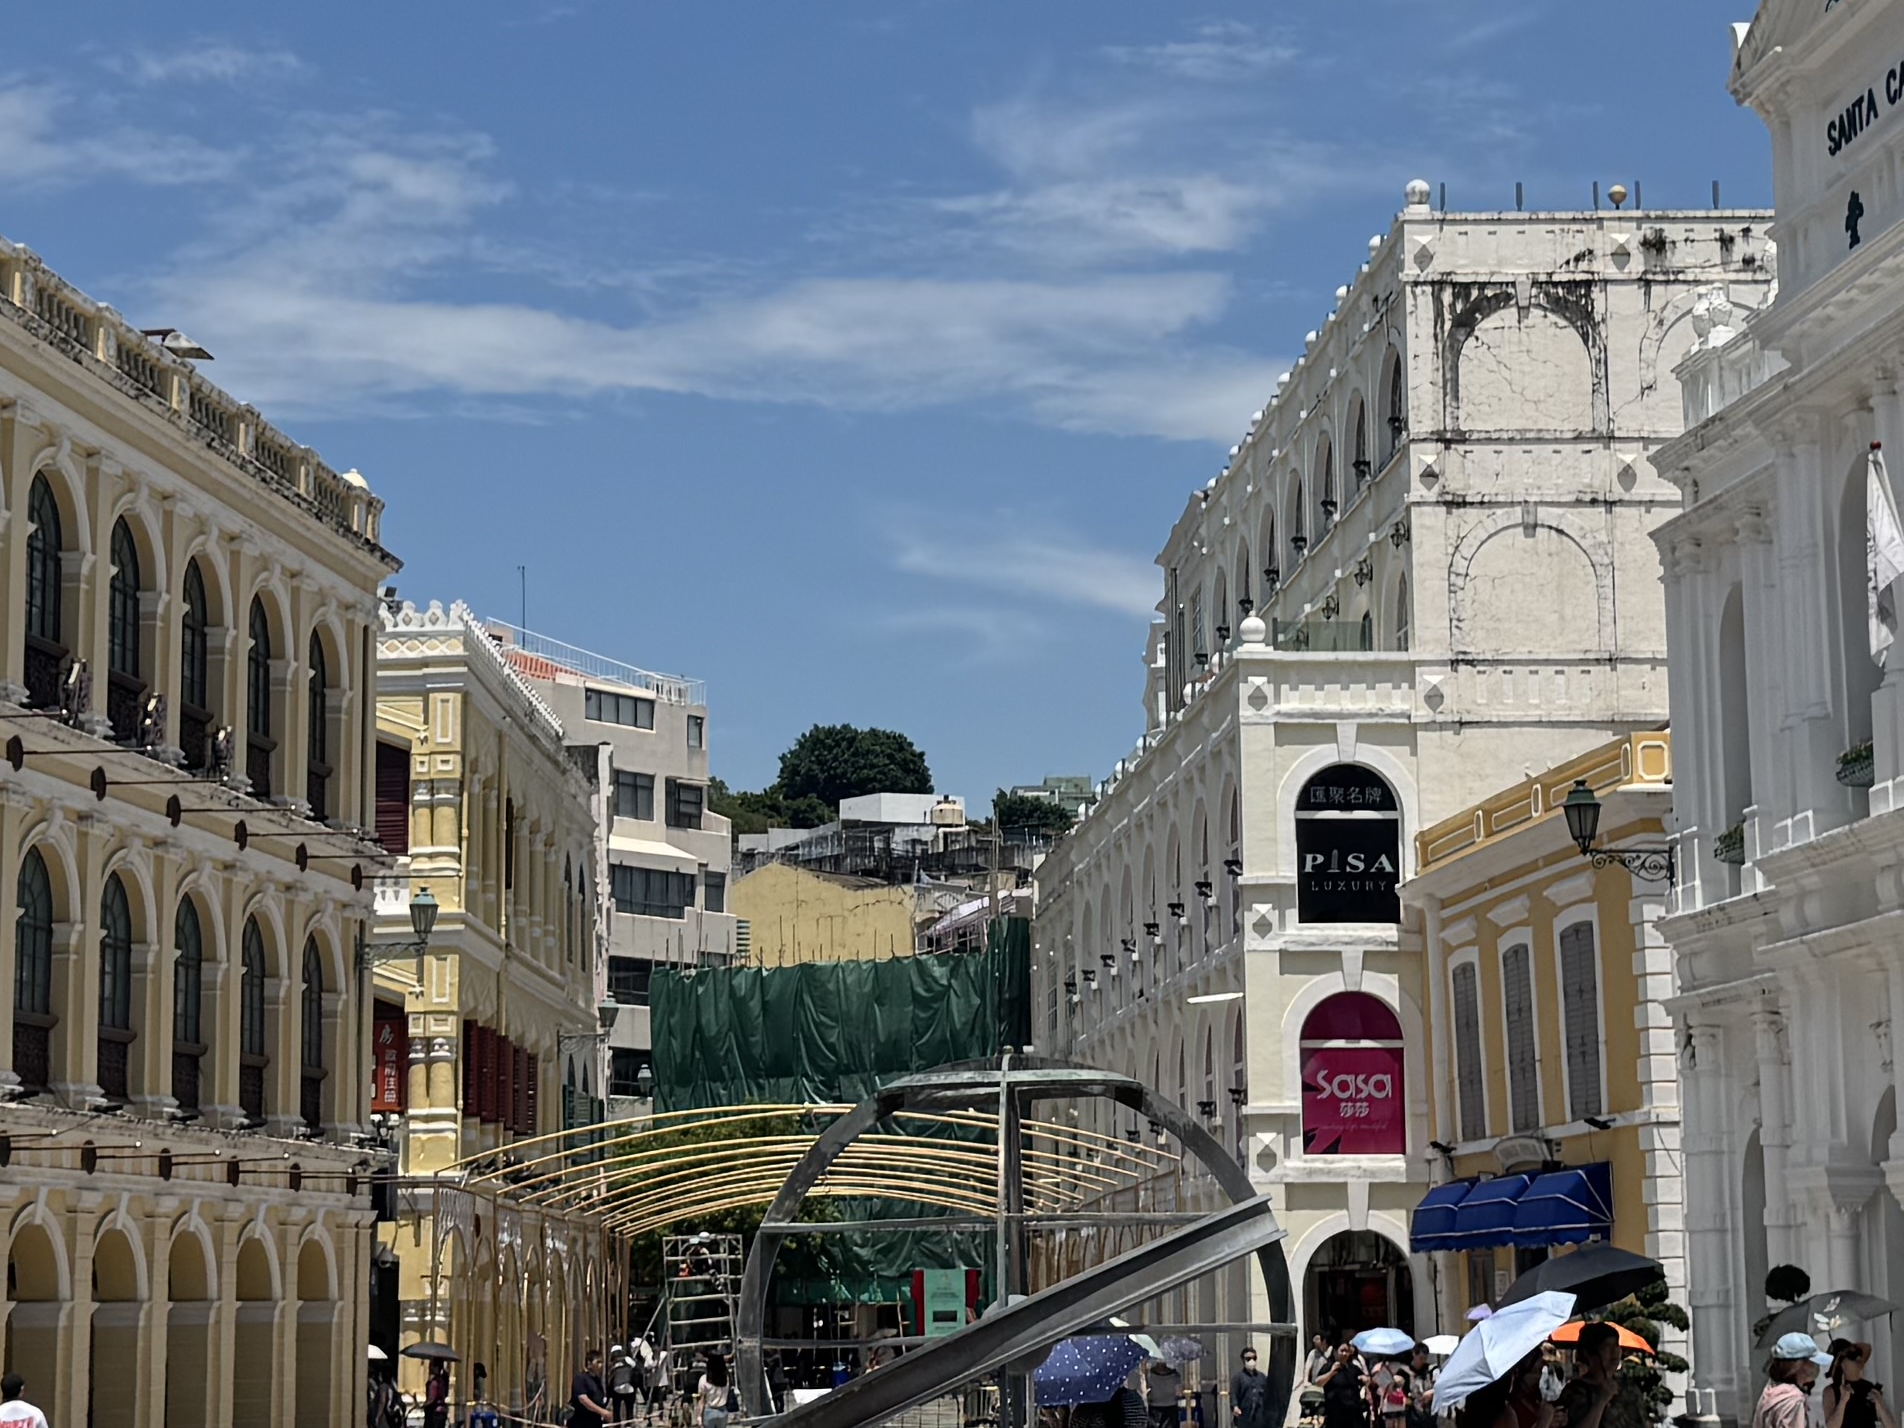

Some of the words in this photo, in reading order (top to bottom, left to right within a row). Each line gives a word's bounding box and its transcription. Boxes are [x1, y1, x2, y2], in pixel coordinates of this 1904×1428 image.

[1827, 87, 1879, 156] SANTA
[1302, 848, 1395, 873] PISA
[1311, 880, 1386, 891] LUXURY
